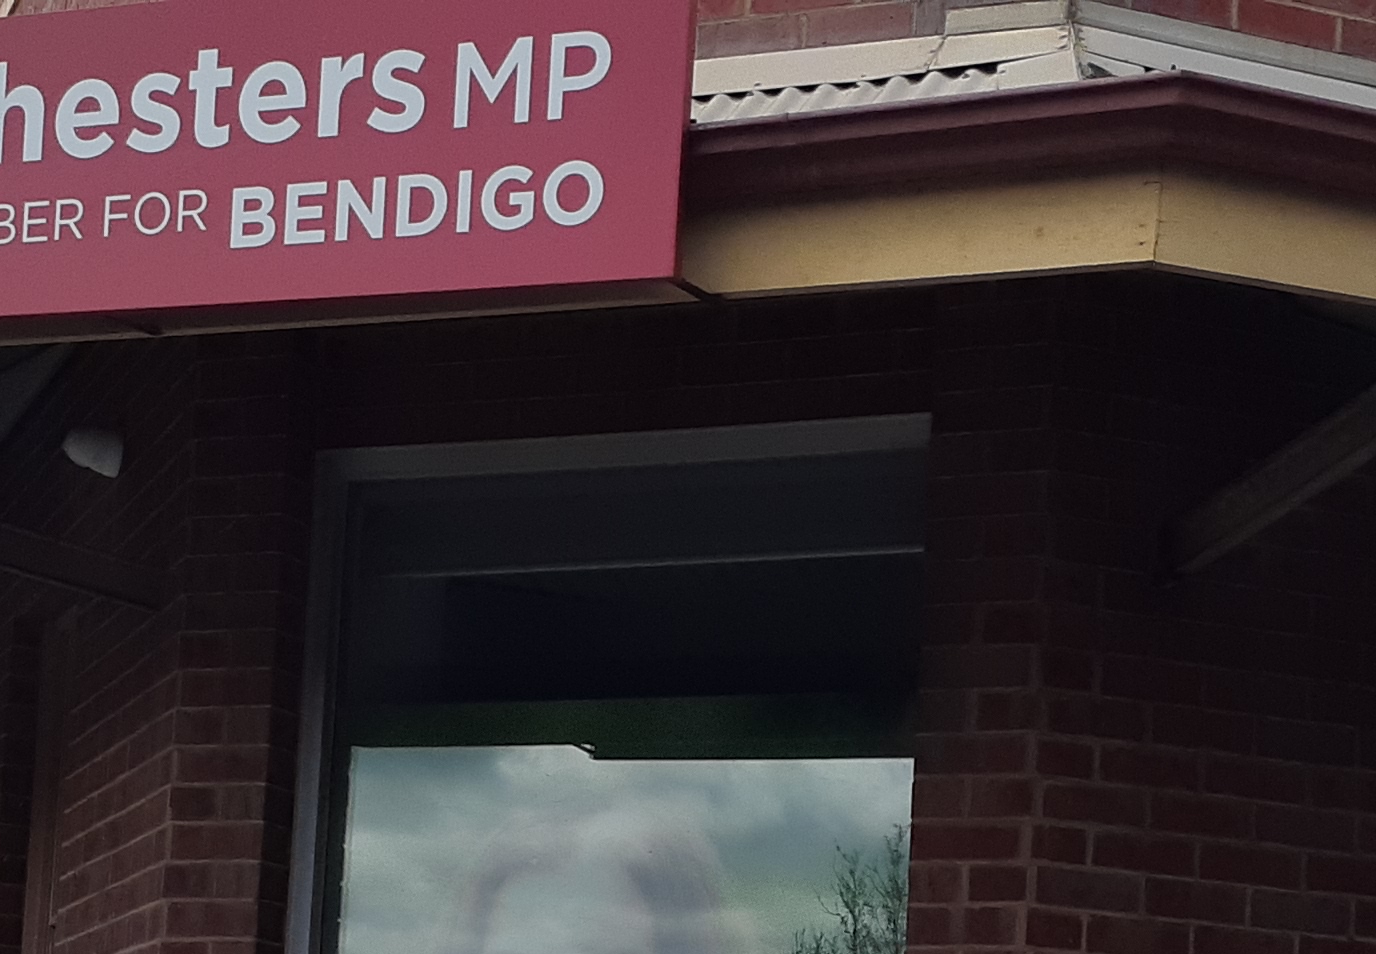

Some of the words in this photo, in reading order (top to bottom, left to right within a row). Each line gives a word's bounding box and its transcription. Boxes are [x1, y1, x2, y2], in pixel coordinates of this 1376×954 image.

[452, 30, 613, 129] MP
[102, 188, 209, 238] FOR
[229, 159, 605, 249] BENDIGO
